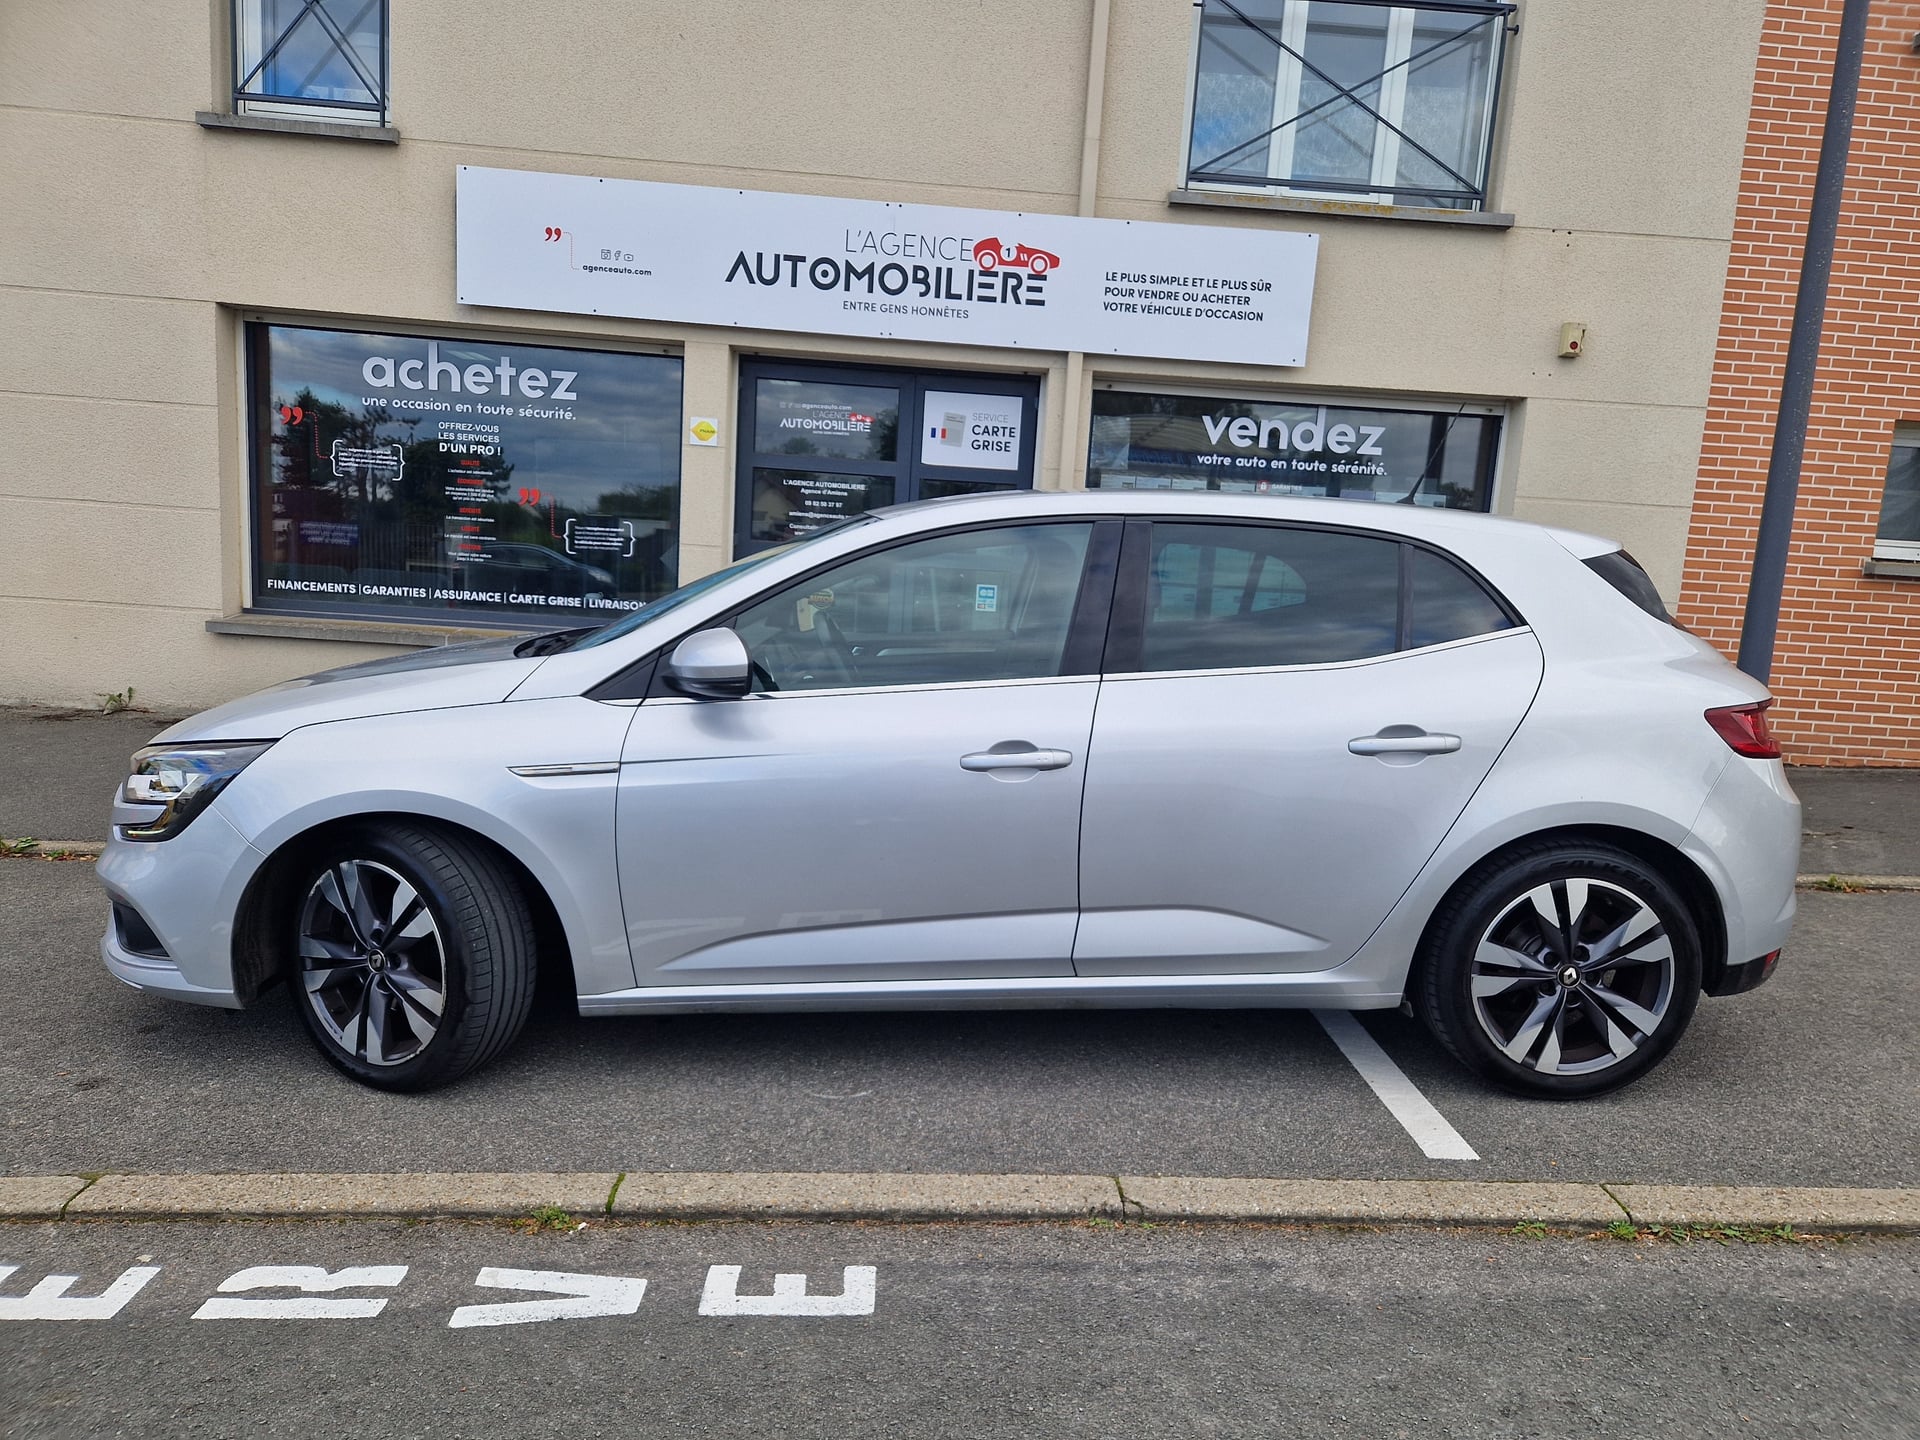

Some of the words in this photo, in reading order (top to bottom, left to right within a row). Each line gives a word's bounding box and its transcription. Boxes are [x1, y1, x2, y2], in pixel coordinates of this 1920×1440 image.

[845, 229, 974, 262] L'AGENCE
[582, 265, 652, 276] agenceauto.com
[1105, 271, 1118, 282] LE
[1119, 272, 1147, 284] PLUS
[1149, 274, 1189, 287] SIMPLE
[1191, 277, 1205, 288] ET
[1206, 278, 1218, 289] LE
[1221, 279, 1248, 291] PLUS
[1250, 279, 1272, 292] SÛR
[1104, 286, 1135, 298] POUR
[1137, 288, 1180, 301] VENDRE
[1182, 292, 1199, 302] OU
[1200, 293, 1251, 306] ACHETER
[843, 300, 877, 312] ENTRE
[879, 303, 908, 314] GENS
[911, 305, 969, 319] HONNÊTES
[1103, 302, 1138, 313] VOTRE
[1140, 302, 1192, 317] VÉHICULE
[1194, 308, 1264, 321] D'OCCASION
[361, 342, 579, 401] achetez
[362, 397, 387, 407] une
[392, 398, 451, 411] occasion
[455, 403, 472, 413] en
[477, 402, 514, 416] toute
[518, 404, 577, 420] sécurité.
[813, 410, 850, 420] L'AGENCE
[972, 412, 1009, 424] SERVICE
[438, 421, 500, 433] OFFREZ-VOUS
[971, 424, 1016, 438] CARTE
[1201, 406, 1386, 456] vendez
[438, 432, 455, 440] LES
[457, 433, 500, 443] SERVICES
[971, 439, 1011, 452] GRISE
[439, 442, 467, 454] D'UN
[470, 444, 495, 456] PRO
[1197, 454, 1232, 466] votre
[1235, 456, 1267, 469] auto
[1270, 460, 1287, 470] en
[1291, 458, 1327, 472] toute
[1330, 459, 1388, 476] sérénité.
[783, 479, 815, 487] L'AGENCE
[268, 579, 356, 594] FINANCEMENTS
[362, 585, 426, 598] GARANTIES
[434, 589, 501, 602] ASSURANCE
[509, 594, 545, 605] CARTE
[548, 596, 582, 607] GRISE
